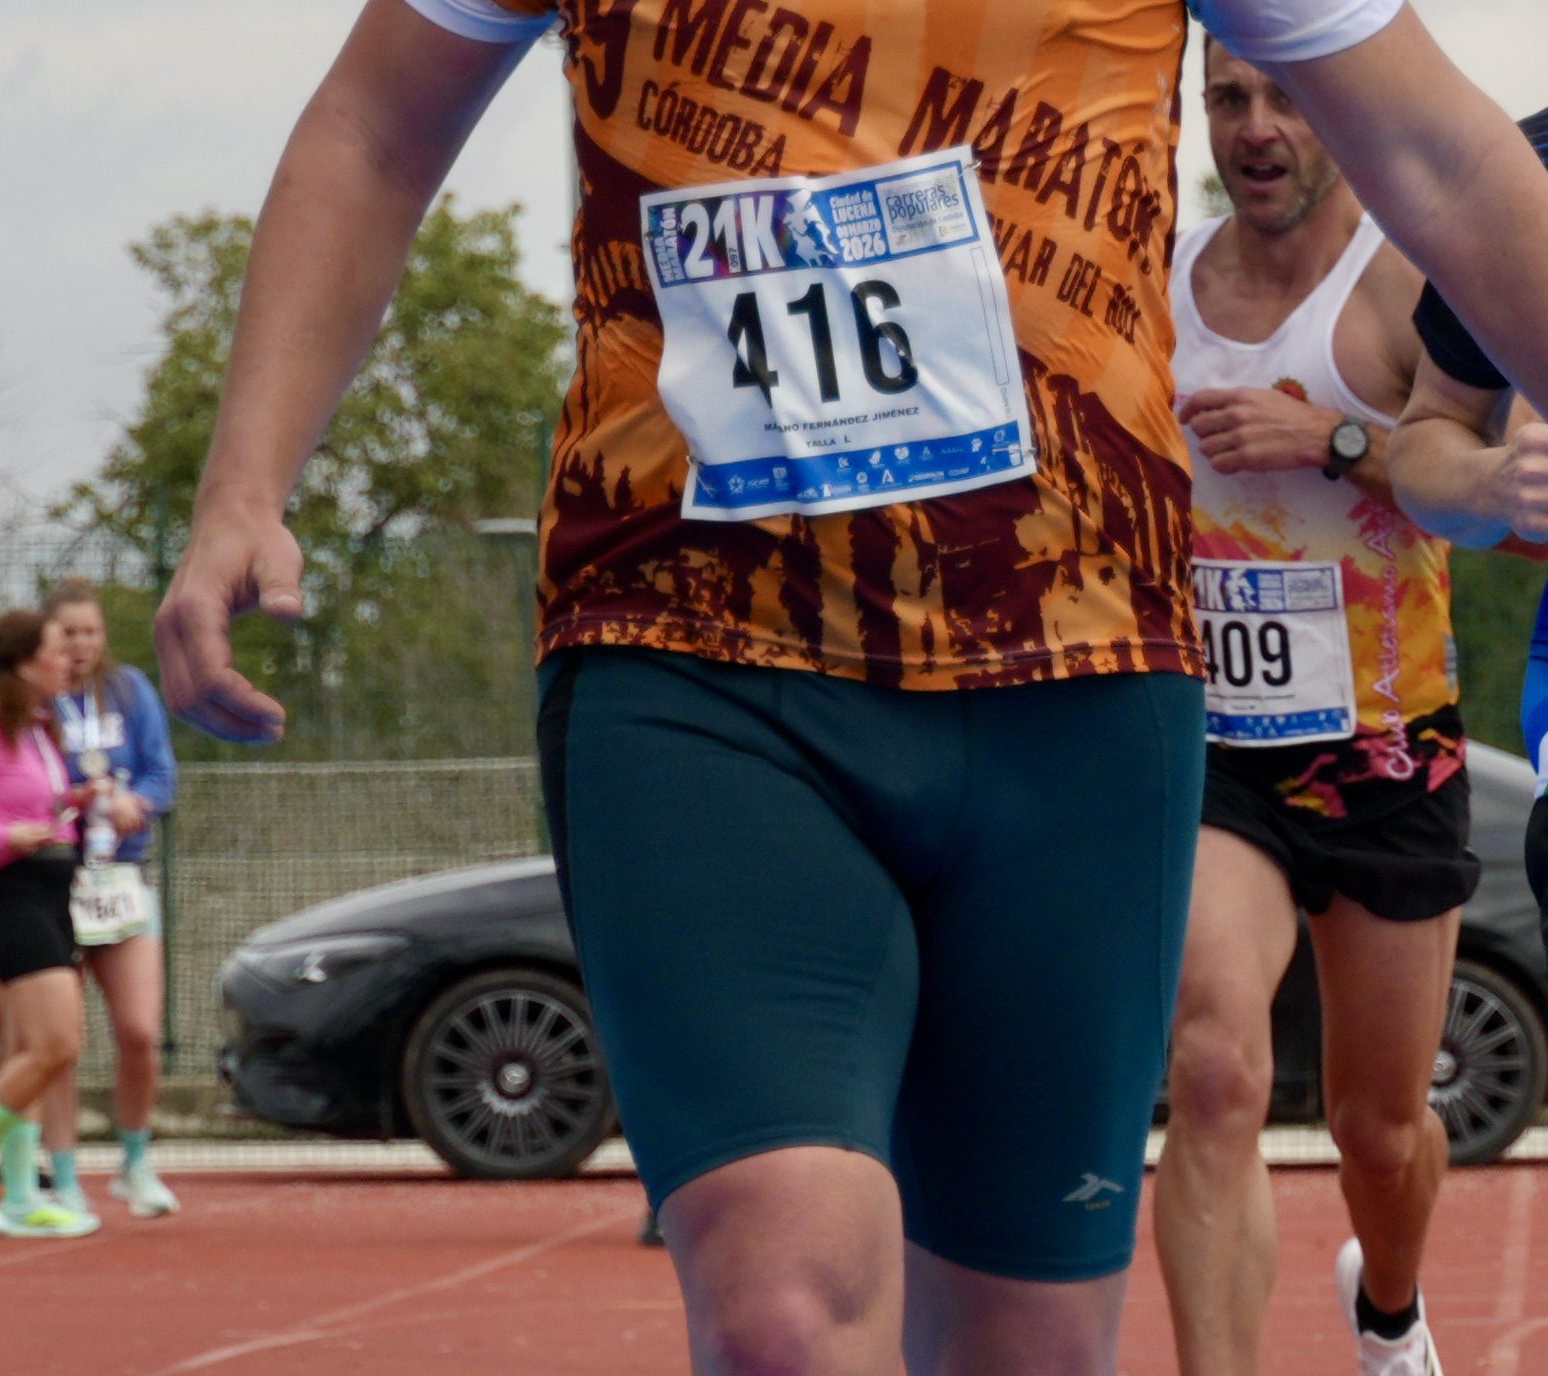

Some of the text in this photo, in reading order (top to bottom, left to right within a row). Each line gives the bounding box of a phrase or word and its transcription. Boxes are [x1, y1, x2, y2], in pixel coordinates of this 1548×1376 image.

[636, 78, 788, 178] CÓRDOBA
[885, 183, 947, 208] carreras
[889, 192, 960, 224] populares
[681, 194, 786, 279] 21K
[840, 232, 887, 262] 2026
[727, 279, 919, 409] 416
[802, 414, 869, 432] FERNÁNDEZ
[872, 406, 920, 422] JIMÉNEZ
[1381, 708, 1415, 780] Club
